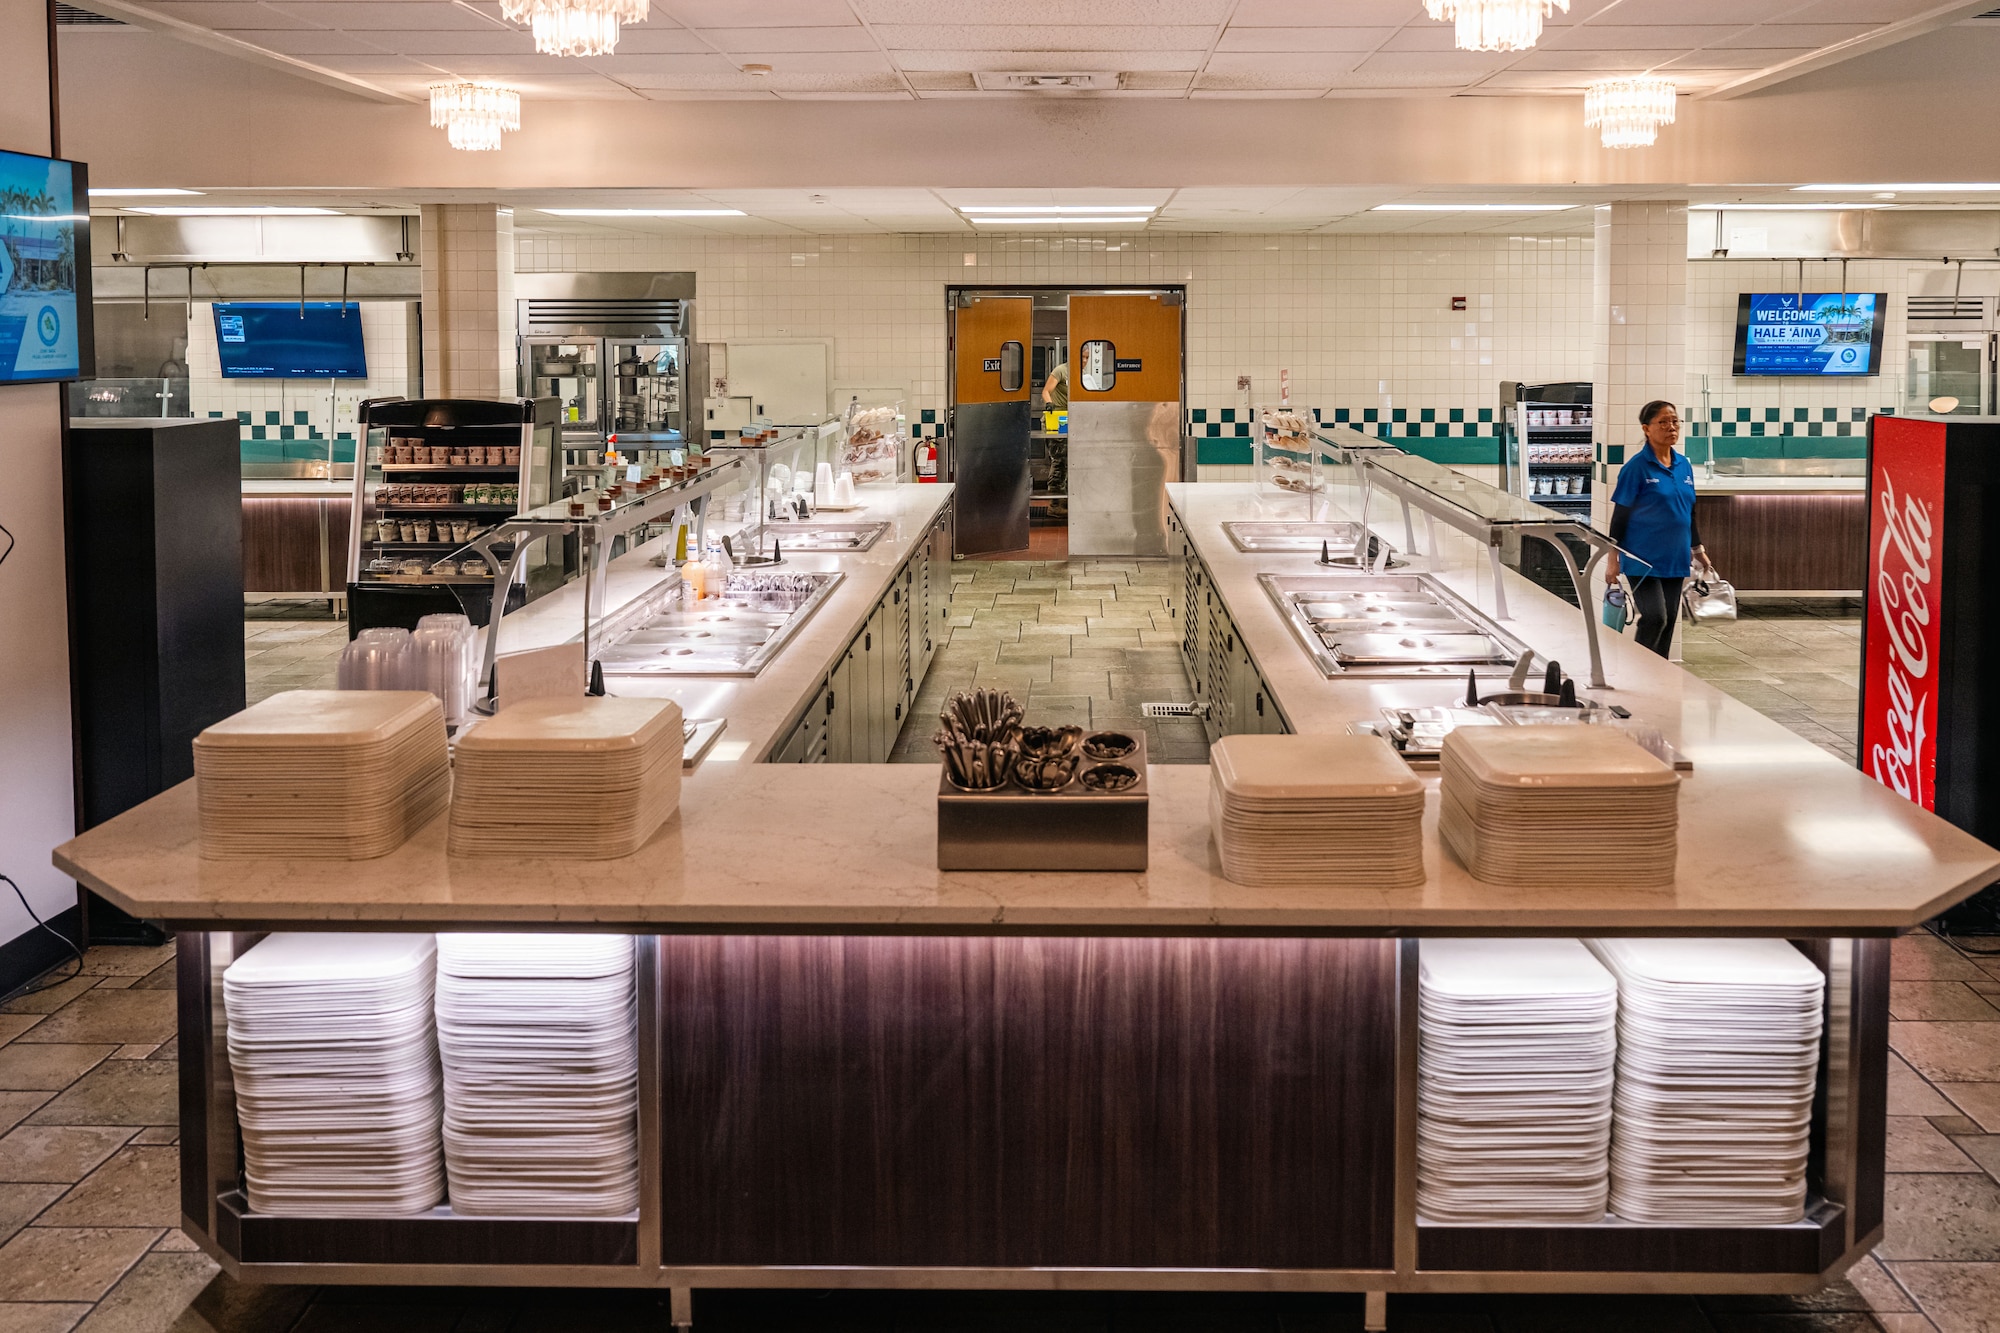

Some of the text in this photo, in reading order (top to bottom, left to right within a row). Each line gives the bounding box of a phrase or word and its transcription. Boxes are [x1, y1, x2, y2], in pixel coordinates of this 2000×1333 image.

[1757, 310, 1816, 321] WELCOME
[1754, 328, 1786, 338] HALE
[985, 360, 1000, 370] Exit
